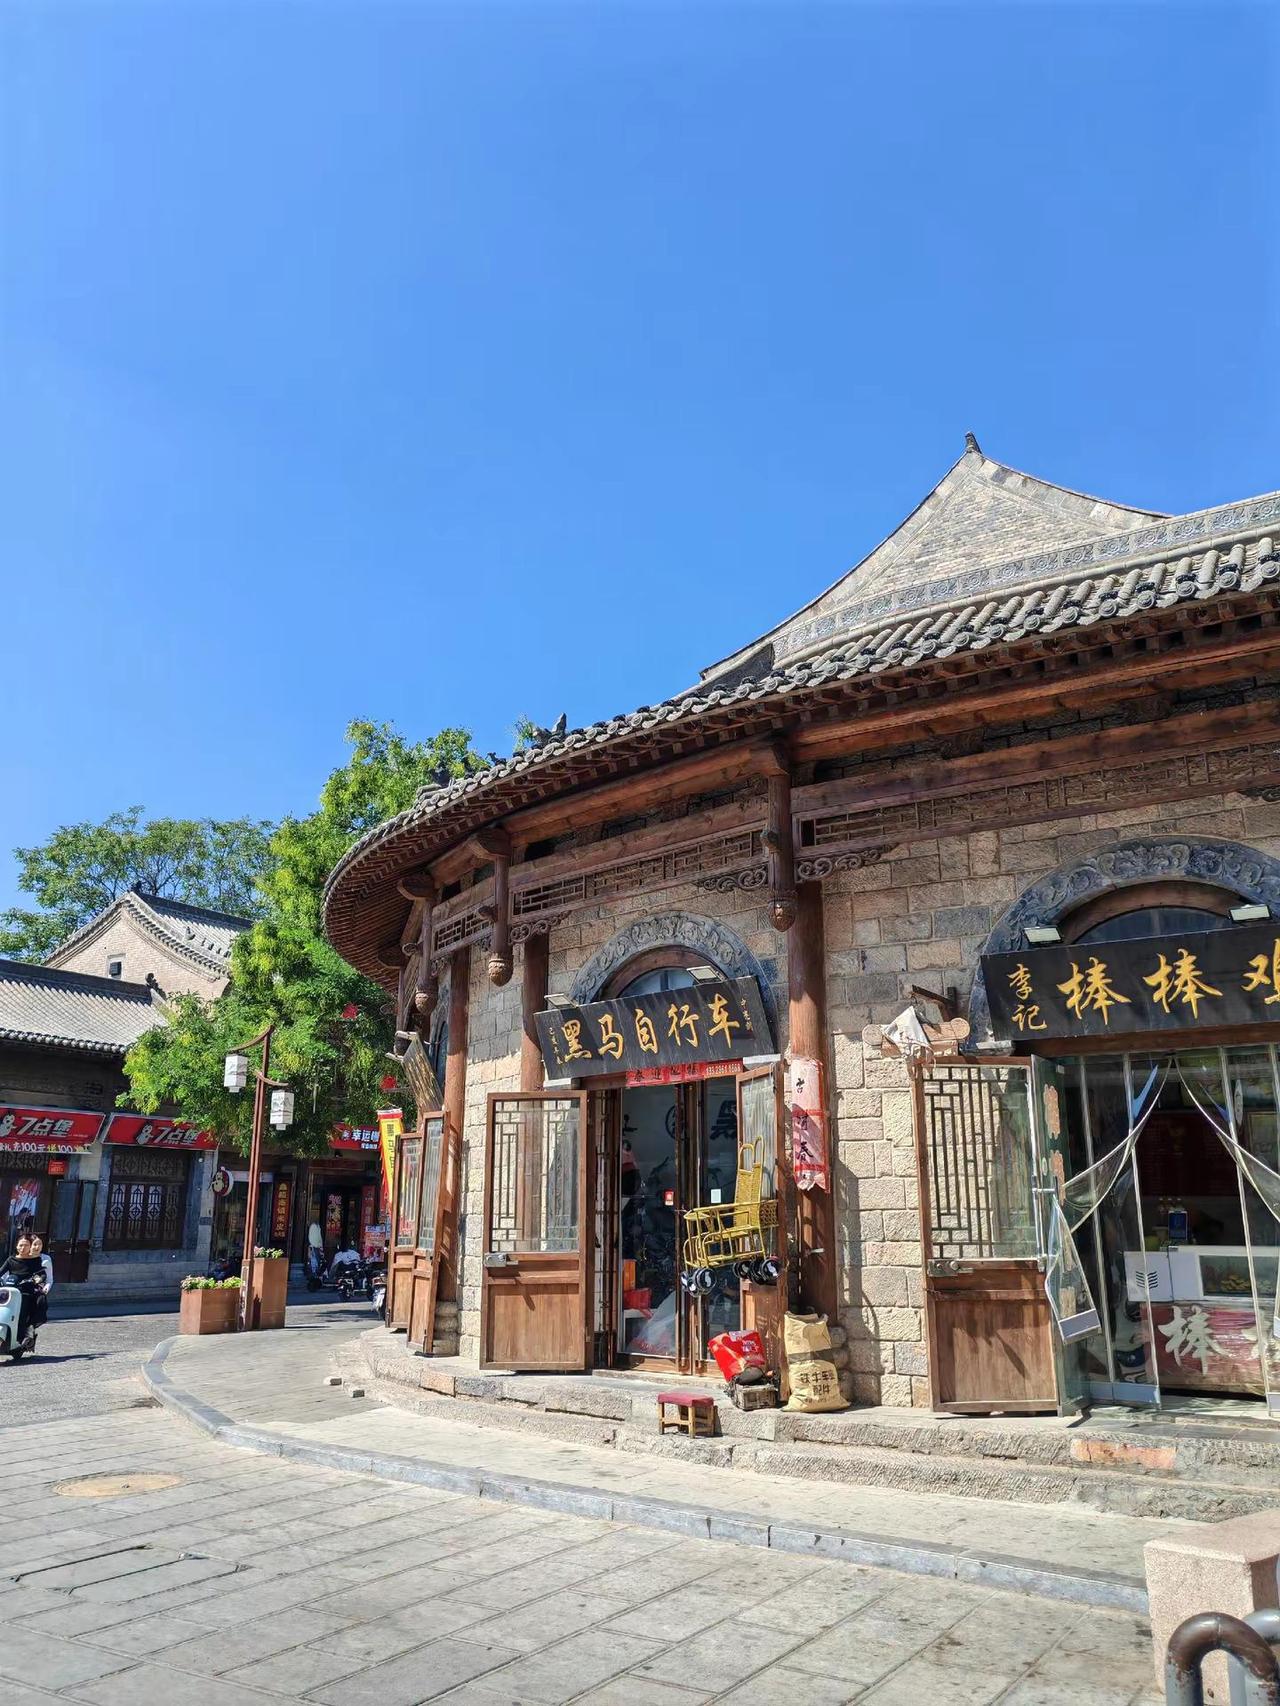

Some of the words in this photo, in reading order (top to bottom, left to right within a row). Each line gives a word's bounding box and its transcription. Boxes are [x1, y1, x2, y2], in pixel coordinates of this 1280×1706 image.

[1007, 964, 1048, 1031] 李记
[561, 994, 740, 1062] 黑马自行车
[17, 1117, 74, 1137] 7点堡
[153, 1126, 201, 1145] 7点堡
